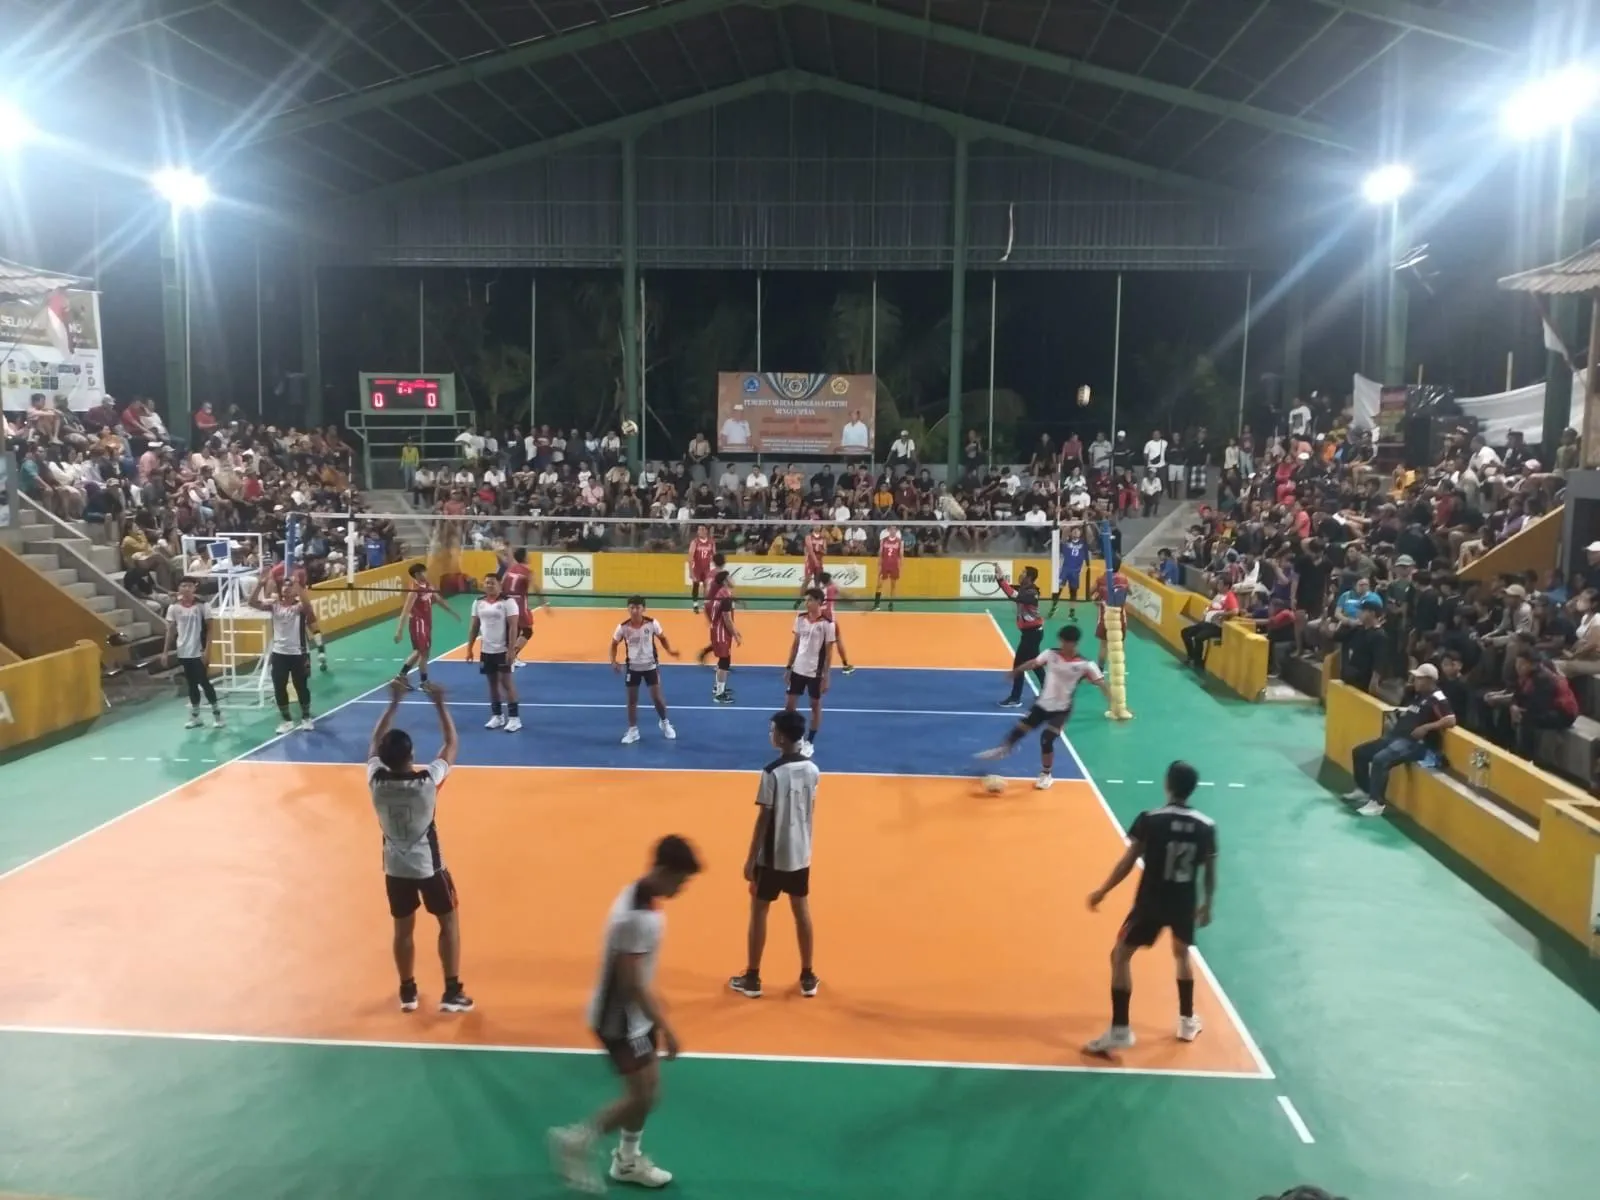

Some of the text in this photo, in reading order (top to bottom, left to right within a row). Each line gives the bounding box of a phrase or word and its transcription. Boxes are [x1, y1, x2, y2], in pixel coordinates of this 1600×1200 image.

[374, 392, 437, 408] 0 0
[544, 567, 591, 577] BALI SWING
[743, 566, 795, 580] Bali
[962, 574, 980, 583] BALI
[310, 575, 402, 621] TEGAL KUNING
